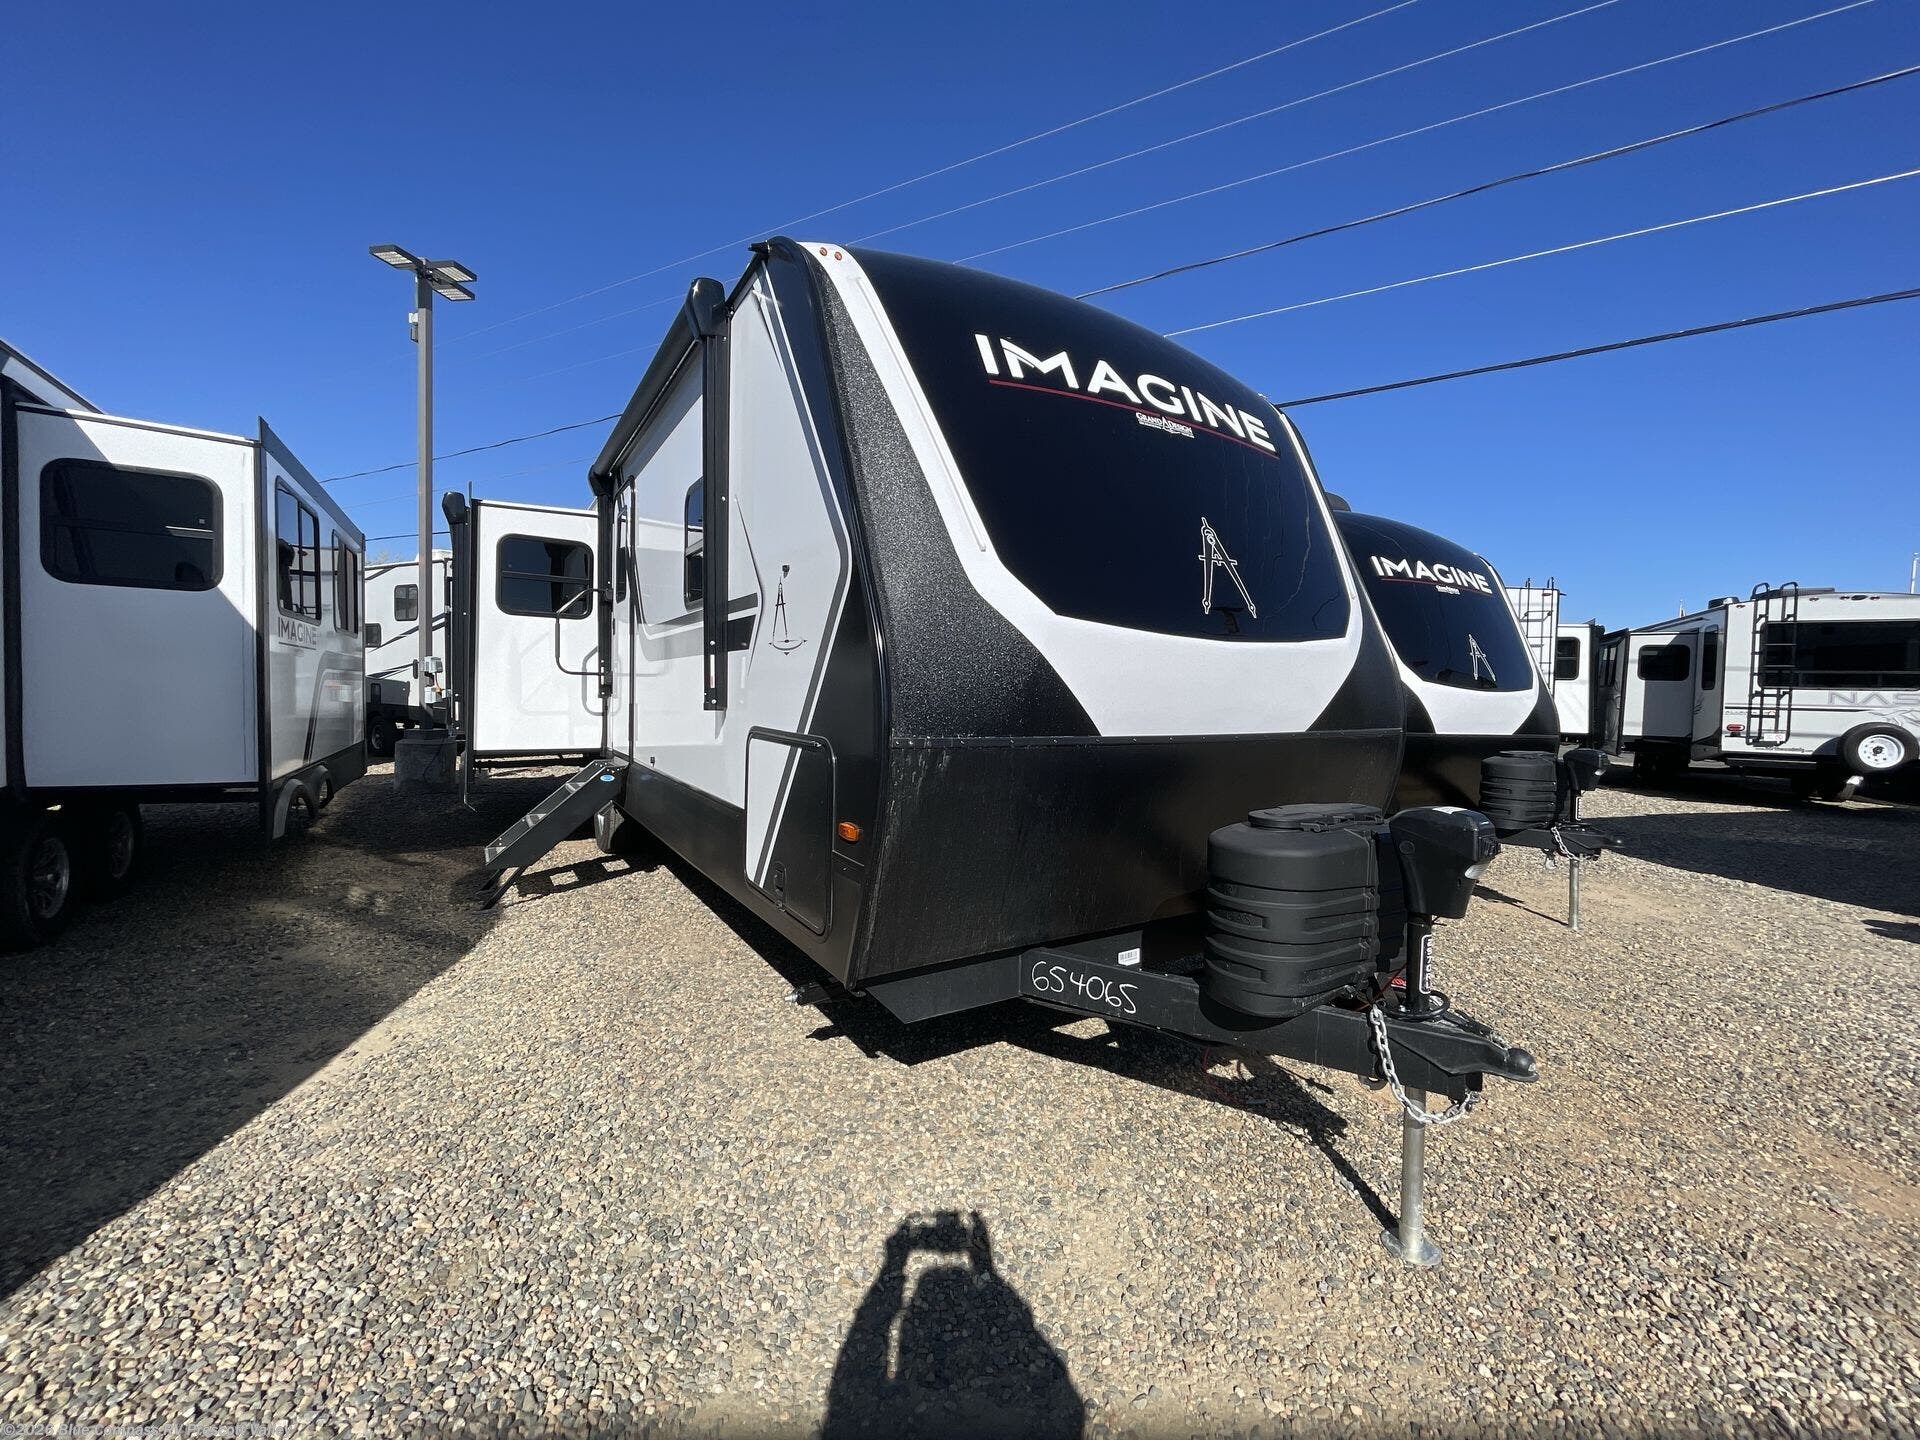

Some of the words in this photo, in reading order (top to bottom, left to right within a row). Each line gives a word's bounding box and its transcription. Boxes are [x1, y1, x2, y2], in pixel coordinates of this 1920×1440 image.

[975, 333, 1276, 452] IMAGINE
[1370, 555, 1493, 594] IMAGINE
[278, 617, 317, 646] IMAGINE
[1032, 961, 1139, 1014] 654065
